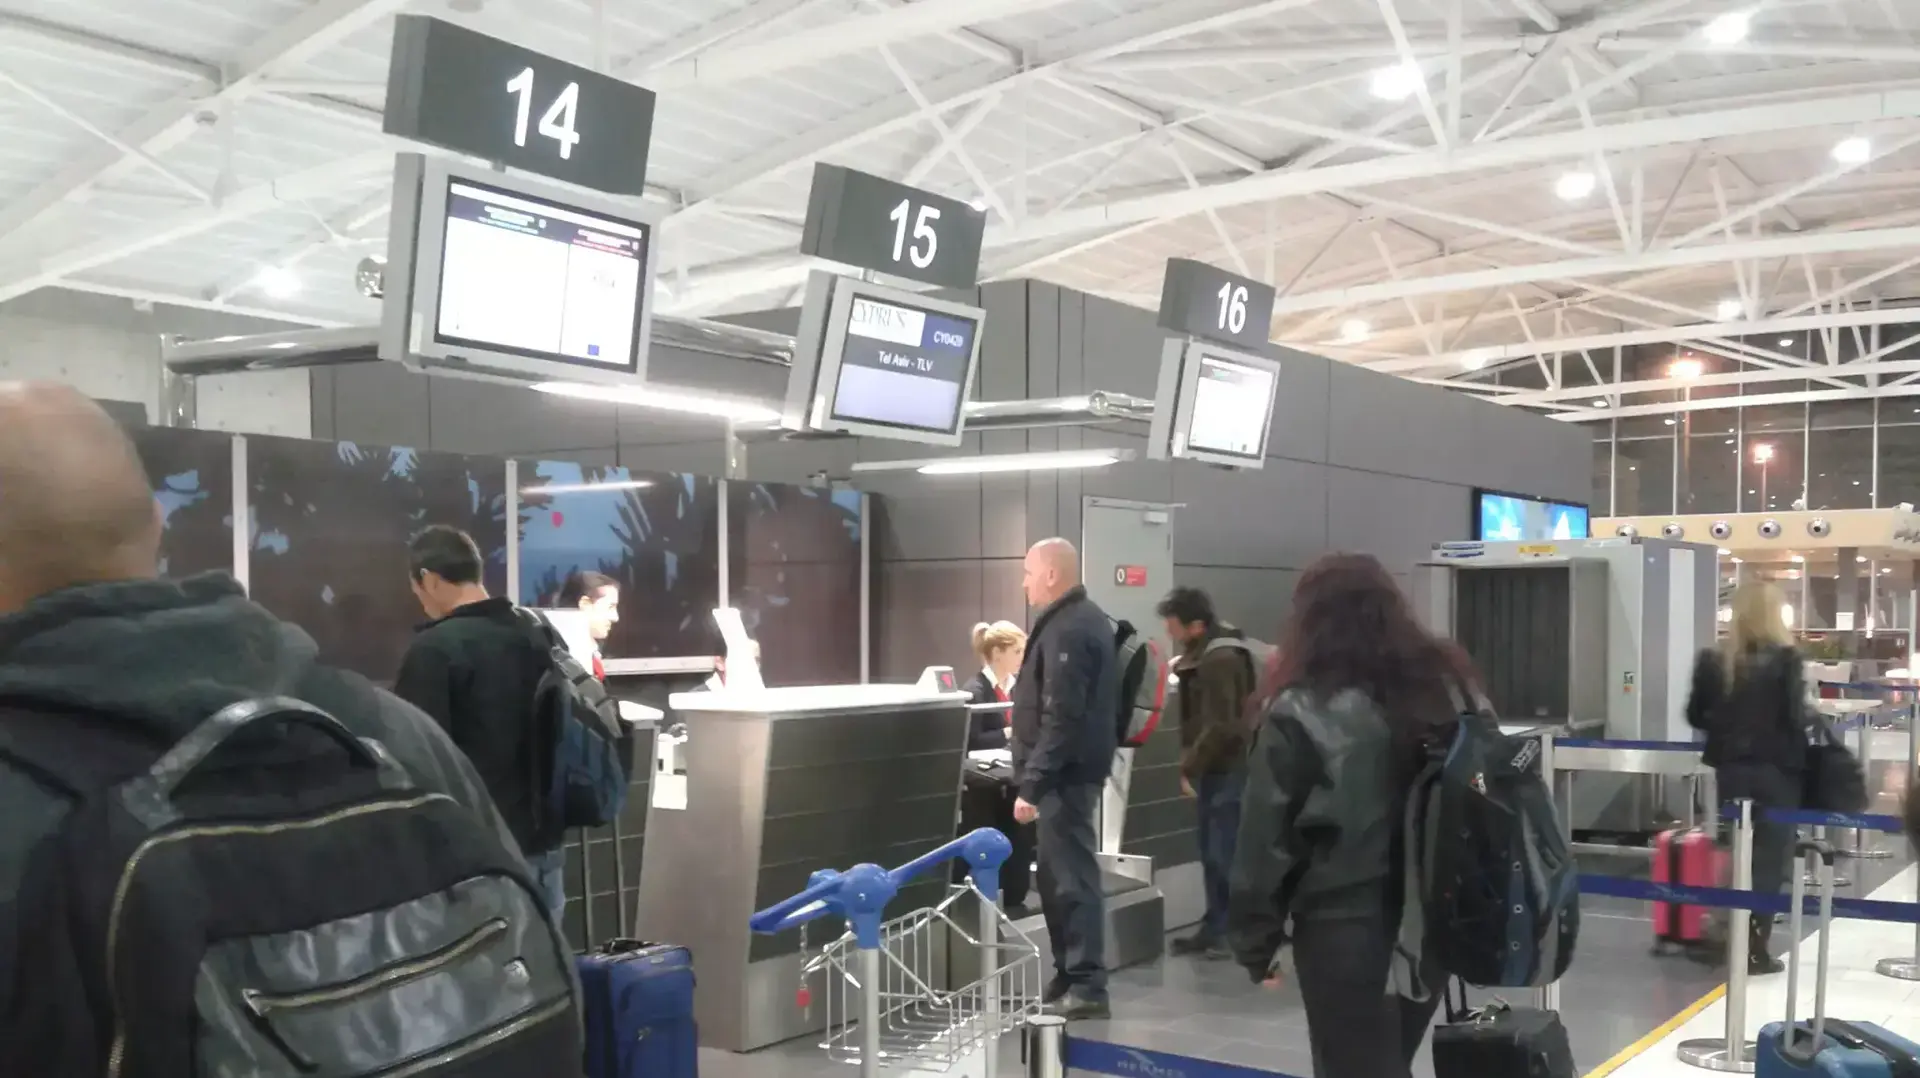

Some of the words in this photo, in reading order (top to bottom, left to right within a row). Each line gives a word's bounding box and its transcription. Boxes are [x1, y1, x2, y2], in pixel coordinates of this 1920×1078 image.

[506, 66, 580, 160] 14
[890, 198, 941, 269] 15
[1217, 281, 1249, 335] 16
[878, 350, 892, 365] Tel
[916, 357, 935, 372] TLV
